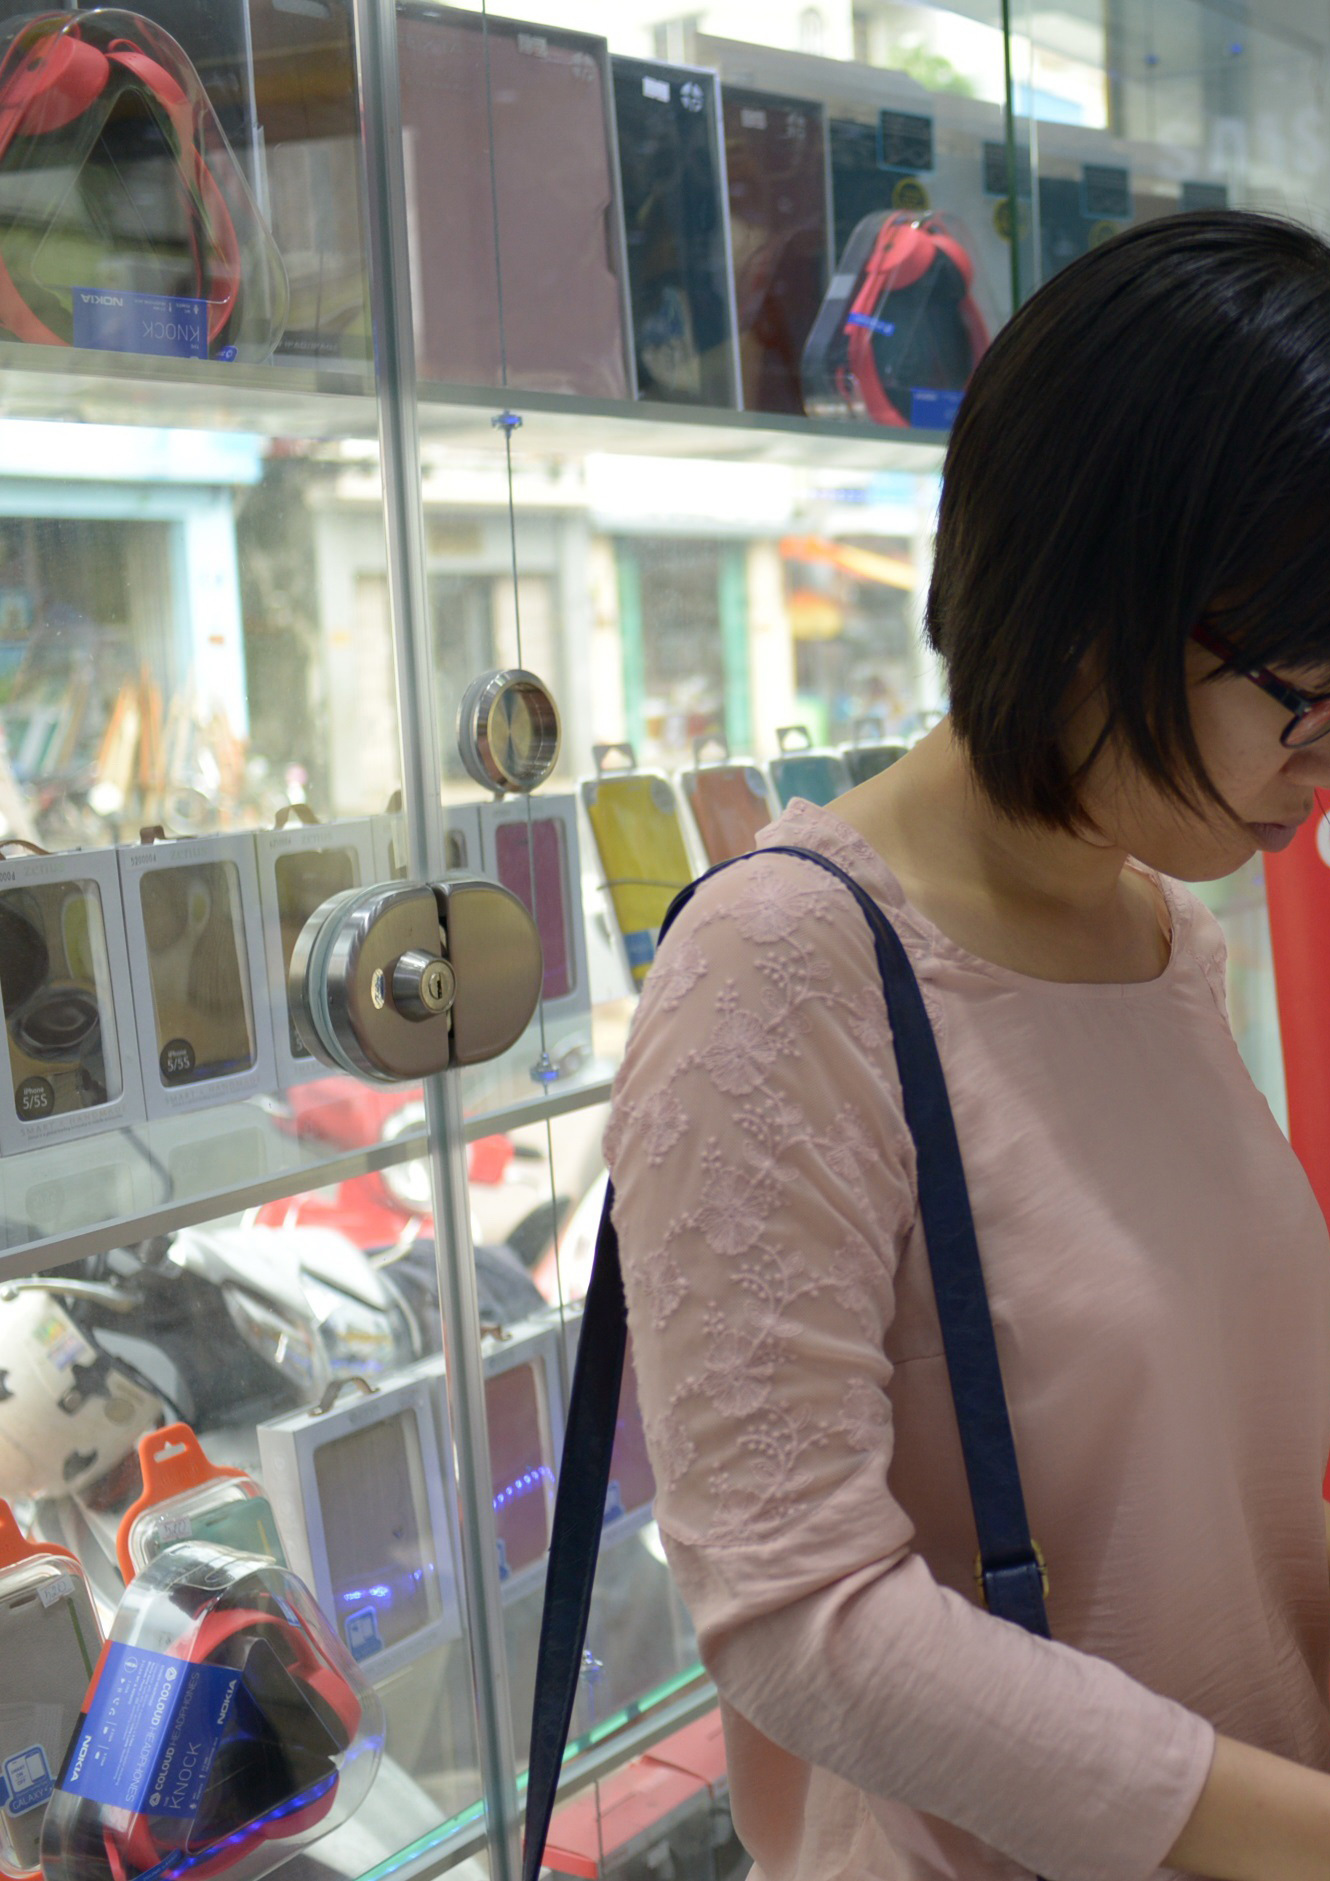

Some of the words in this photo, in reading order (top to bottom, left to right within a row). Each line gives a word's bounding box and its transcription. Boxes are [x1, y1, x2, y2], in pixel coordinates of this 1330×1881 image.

[81, 293, 124, 307] NOKIA
[143, 321, 200, 342] KNOCK
[167, 1056, 190, 1071] 5/5S
[22, 1095, 48, 1110] 5/5S
[23, 1086, 44, 1096] iPhone
[151, 1682, 172, 1726] COLOUD
[217, 1679, 237, 1725] NOKIA
[155, 1747, 175, 1791] COLOUD
[169, 1672, 200, 1746] HEADPHONES
[70, 1735, 92, 1783] NOKIA
[126, 1725, 159, 1802] HEADPHONES
[169, 1741, 202, 1809] KNOCK
